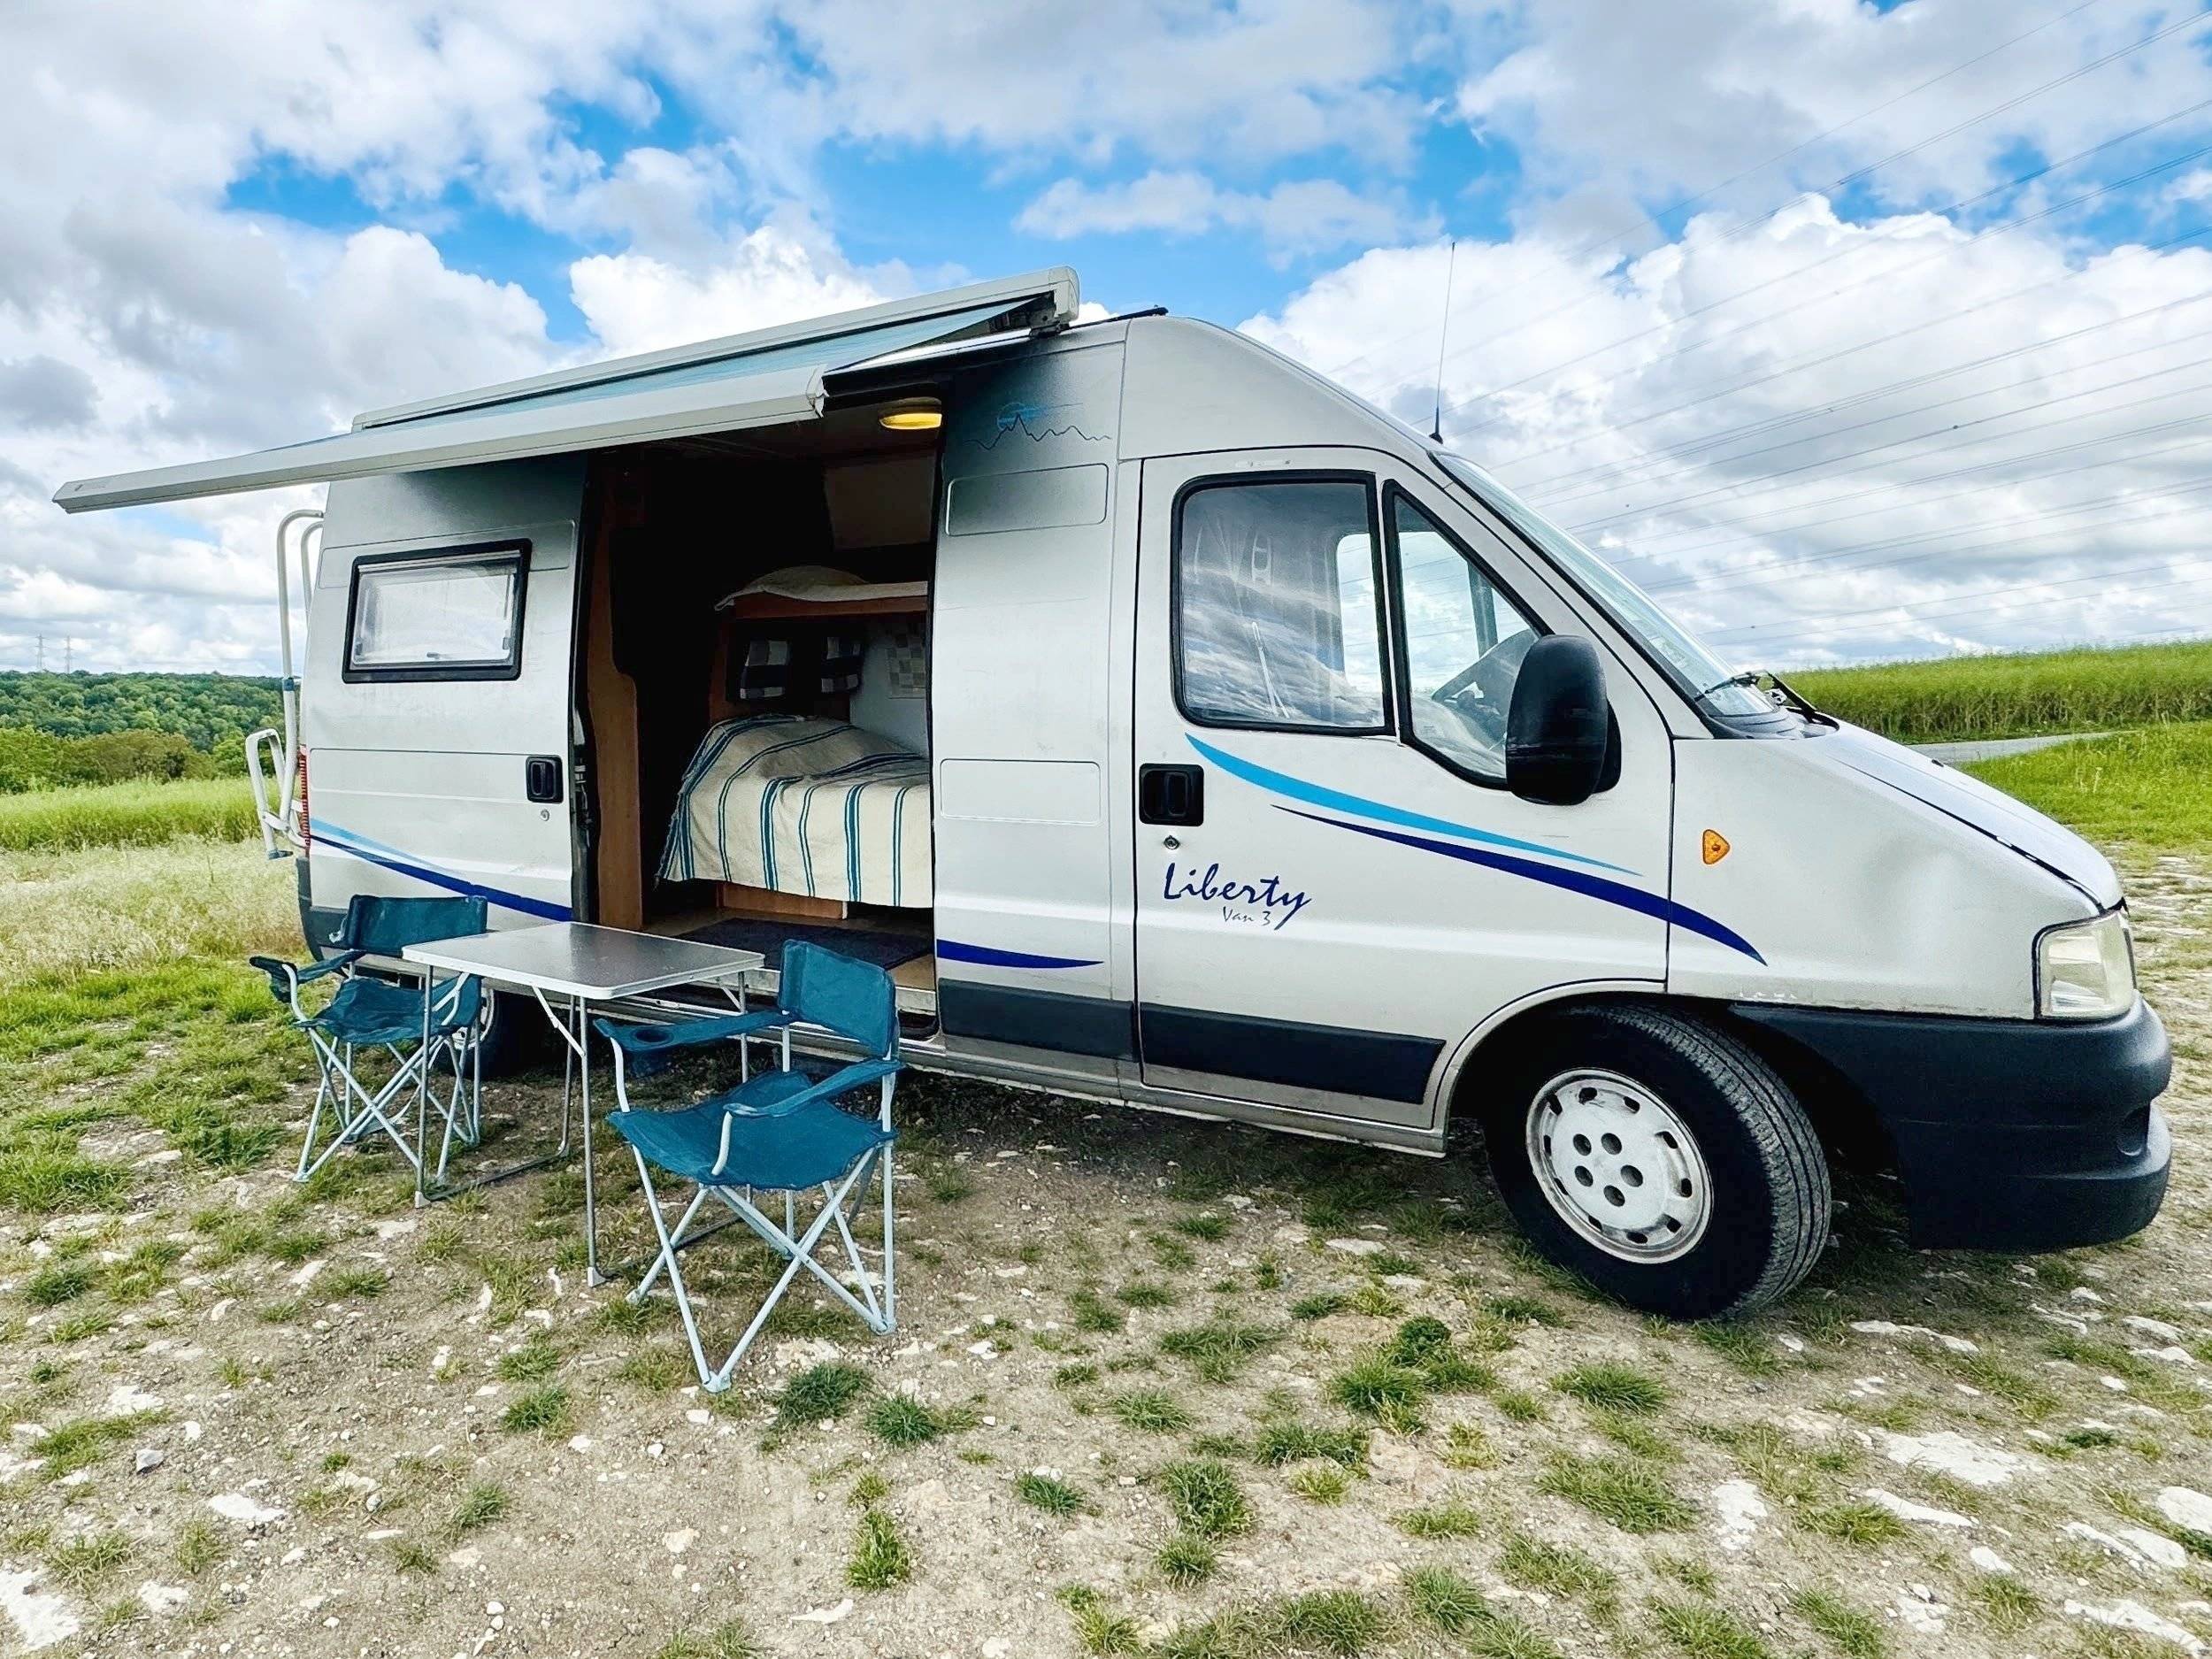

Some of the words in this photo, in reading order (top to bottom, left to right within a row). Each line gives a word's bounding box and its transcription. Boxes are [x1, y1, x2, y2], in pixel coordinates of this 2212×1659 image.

[1164, 862, 1312, 931] Liberty
[1222, 906, 1255, 923] Van
[1262, 910, 1271, 926] 3
